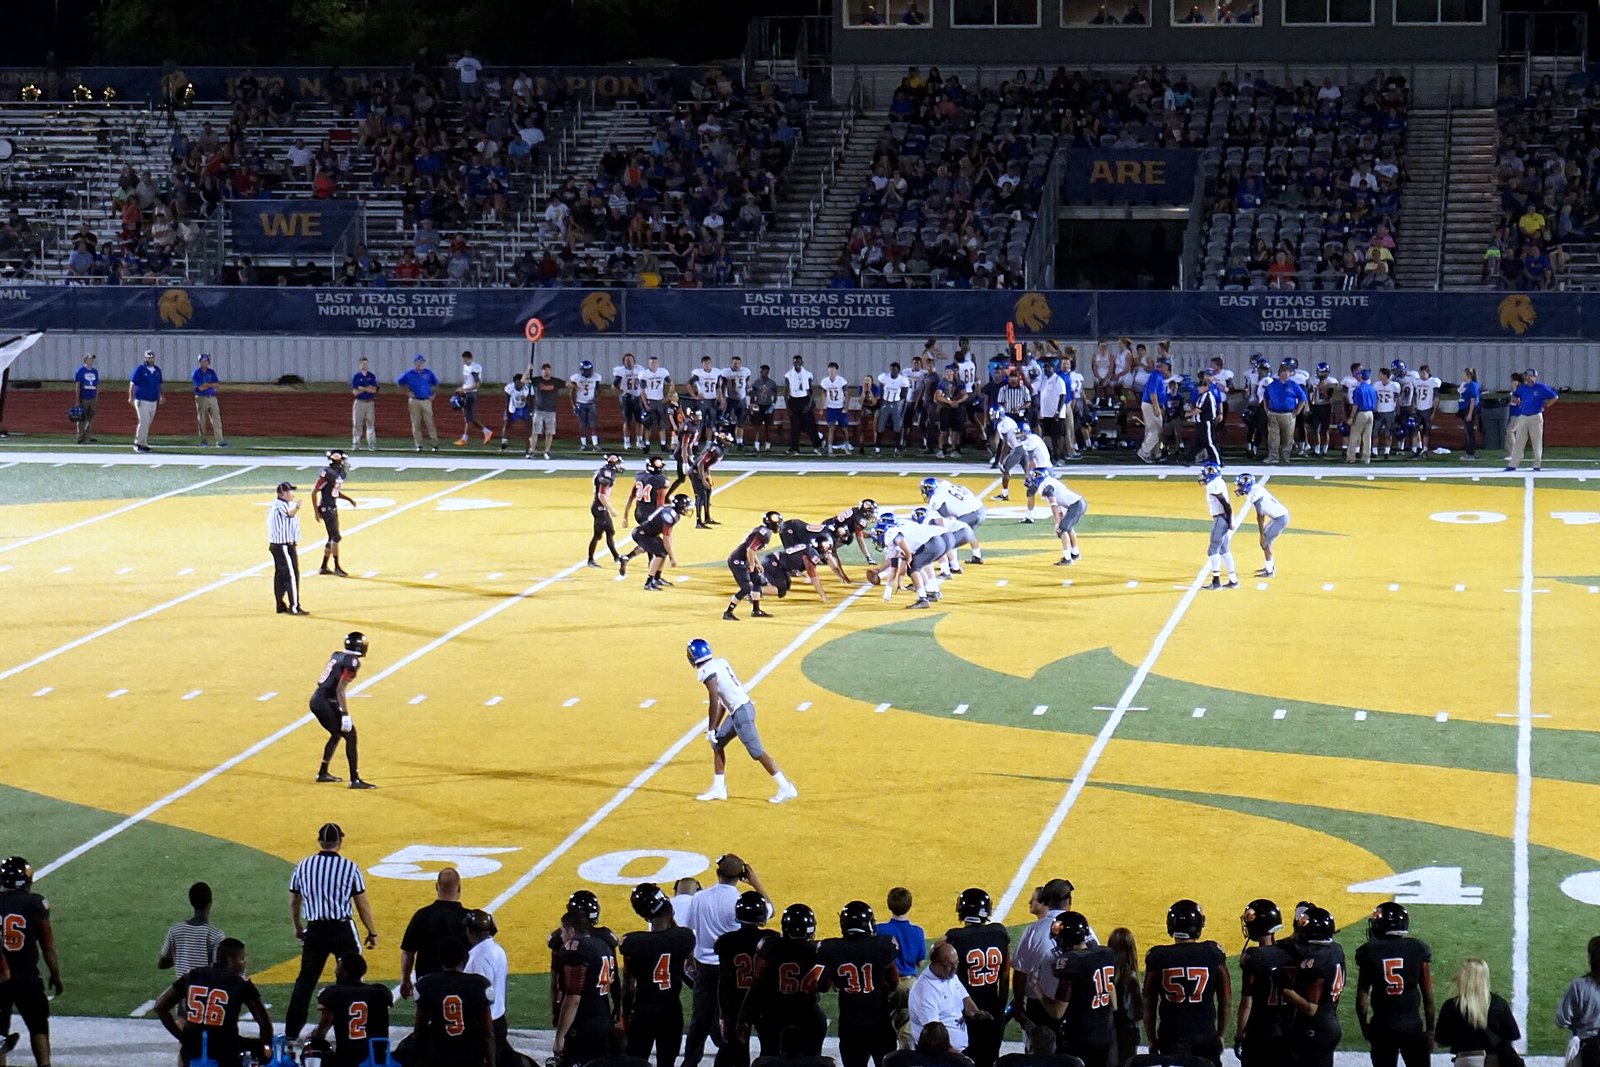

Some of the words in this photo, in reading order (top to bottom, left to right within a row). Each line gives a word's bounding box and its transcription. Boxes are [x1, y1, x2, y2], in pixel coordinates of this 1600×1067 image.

[1089, 160, 1167, 185] ARE
[258, 212, 322, 237] WE
[315, 293, 353, 304] EAST
[359, 293, 406, 304] TEXAS
[412, 294, 457, 304] STATE
[318, 305, 382, 316] NORMAL
[388, 306, 453, 317] COLLEGE
[745, 293, 783, 304] EAST
[789, 293, 838, 304] TEXAS
[844, 294, 890, 304] STATE
[1219, 295, 1258, 306] EAST
[1265, 296, 1315, 307] TEXAS
[1321, 296, 1369, 306] STATE
[356, 318, 416, 329] 1917-1923
[741, 306, 821, 317] TEACHERS
[827, 306, 895, 317] COLLEGE
[785, 318, 850, 329] 1923-1957
[1261, 308, 1331, 319] COLLEGE
[1260, 320, 1327, 332] 1957-1962
[1013, 343, 1023, 362] 1
[0, 913, 26, 951] 6
[653, 953, 672, 990] 4
[778, 962, 825, 994] 64
[836, 963, 875, 994] 31
[966, 946, 1003, 987] 29
[1382, 957, 1405, 996] 5
[1091, 966, 1115, 1010] 15
[1162, 966, 1210, 1003] 57
[186, 985, 229, 1027] 56
[442, 995, 465, 1037] 9
[349, 1001, 369, 1039] 2
